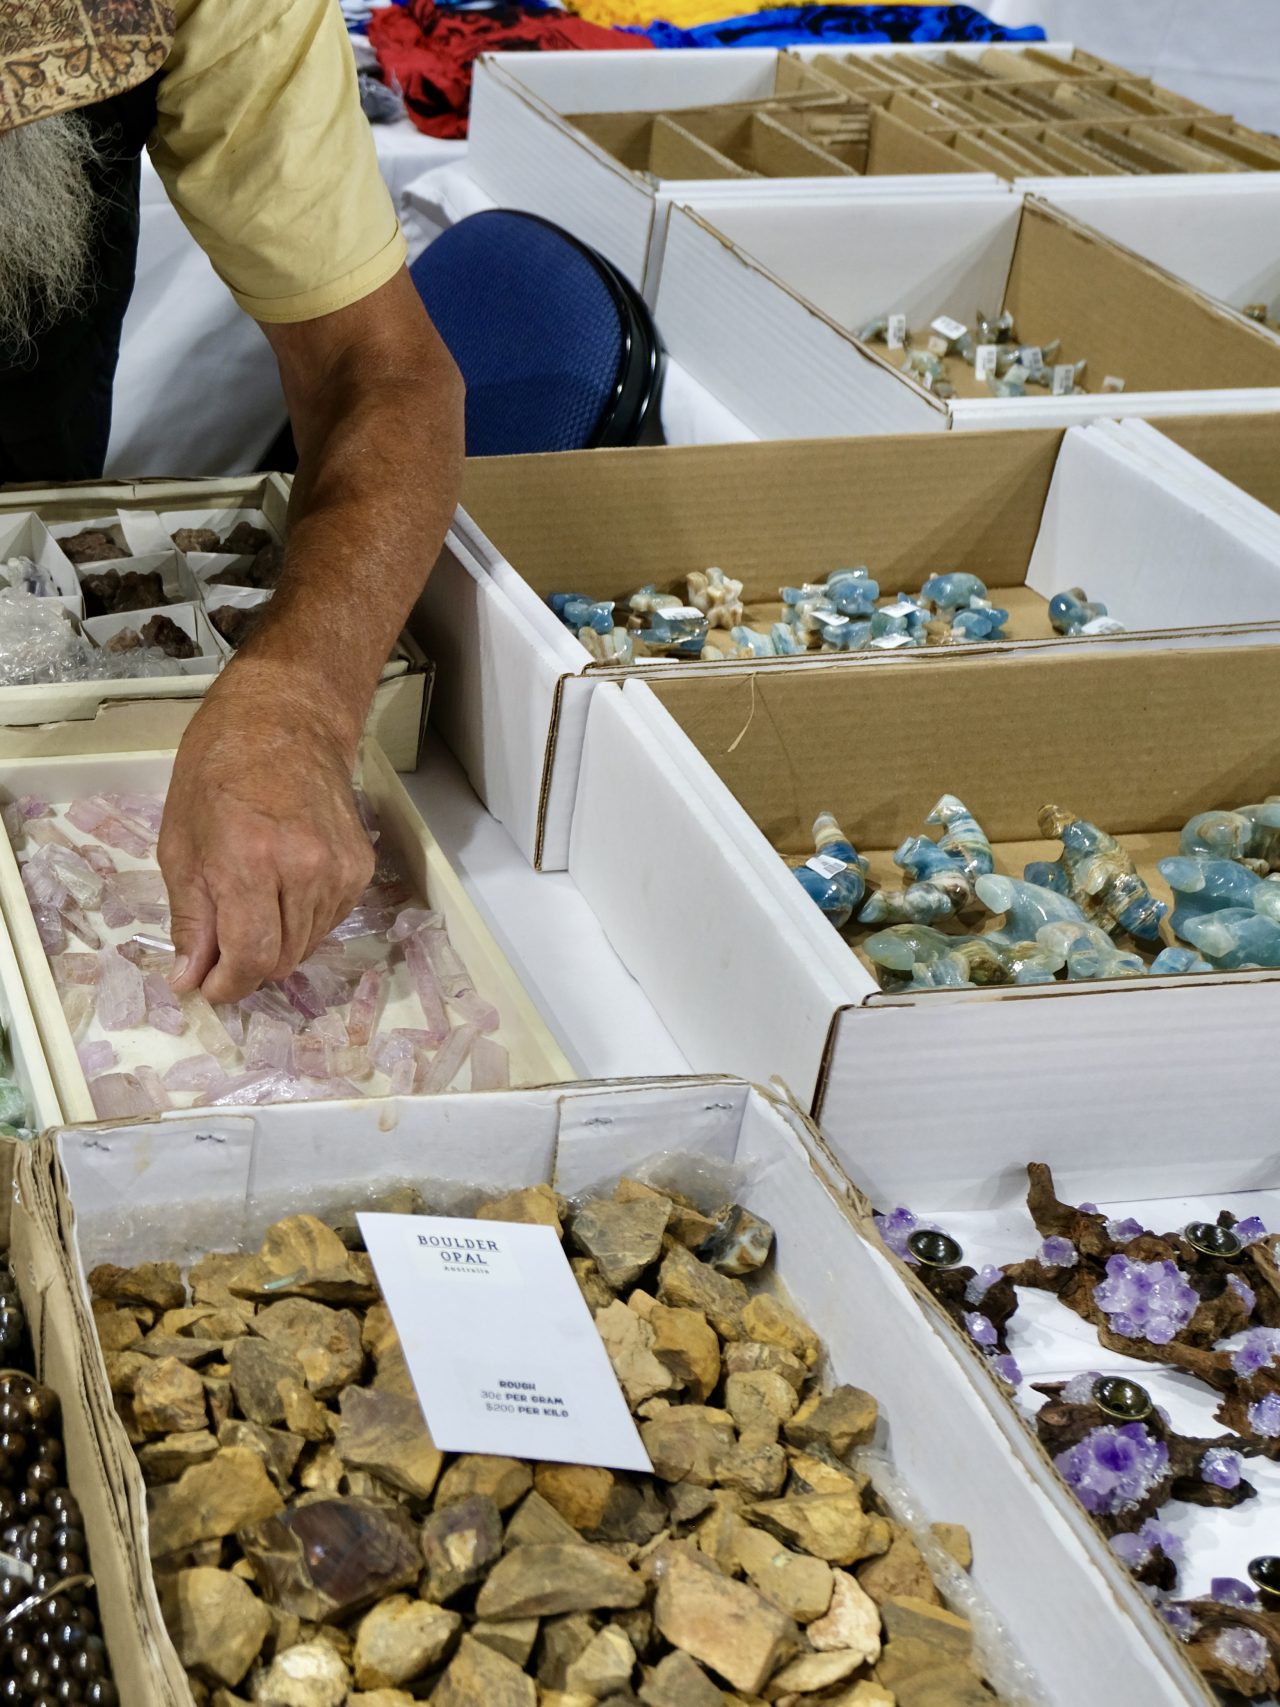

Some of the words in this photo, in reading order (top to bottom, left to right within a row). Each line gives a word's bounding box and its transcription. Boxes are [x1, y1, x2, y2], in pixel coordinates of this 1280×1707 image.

[417, 1235, 499, 1251] BOULDER
[440, 1250, 488, 1264] OPAL
[499, 1380, 537, 1391] ROUGH
[505, 1393, 528, 1402] PER
[531, 1395, 564, 1405] GRAM
[486, 1402, 515, 1413] $200
[518, 1406, 540, 1415] PER
[543, 1408, 569, 1418] KILO
